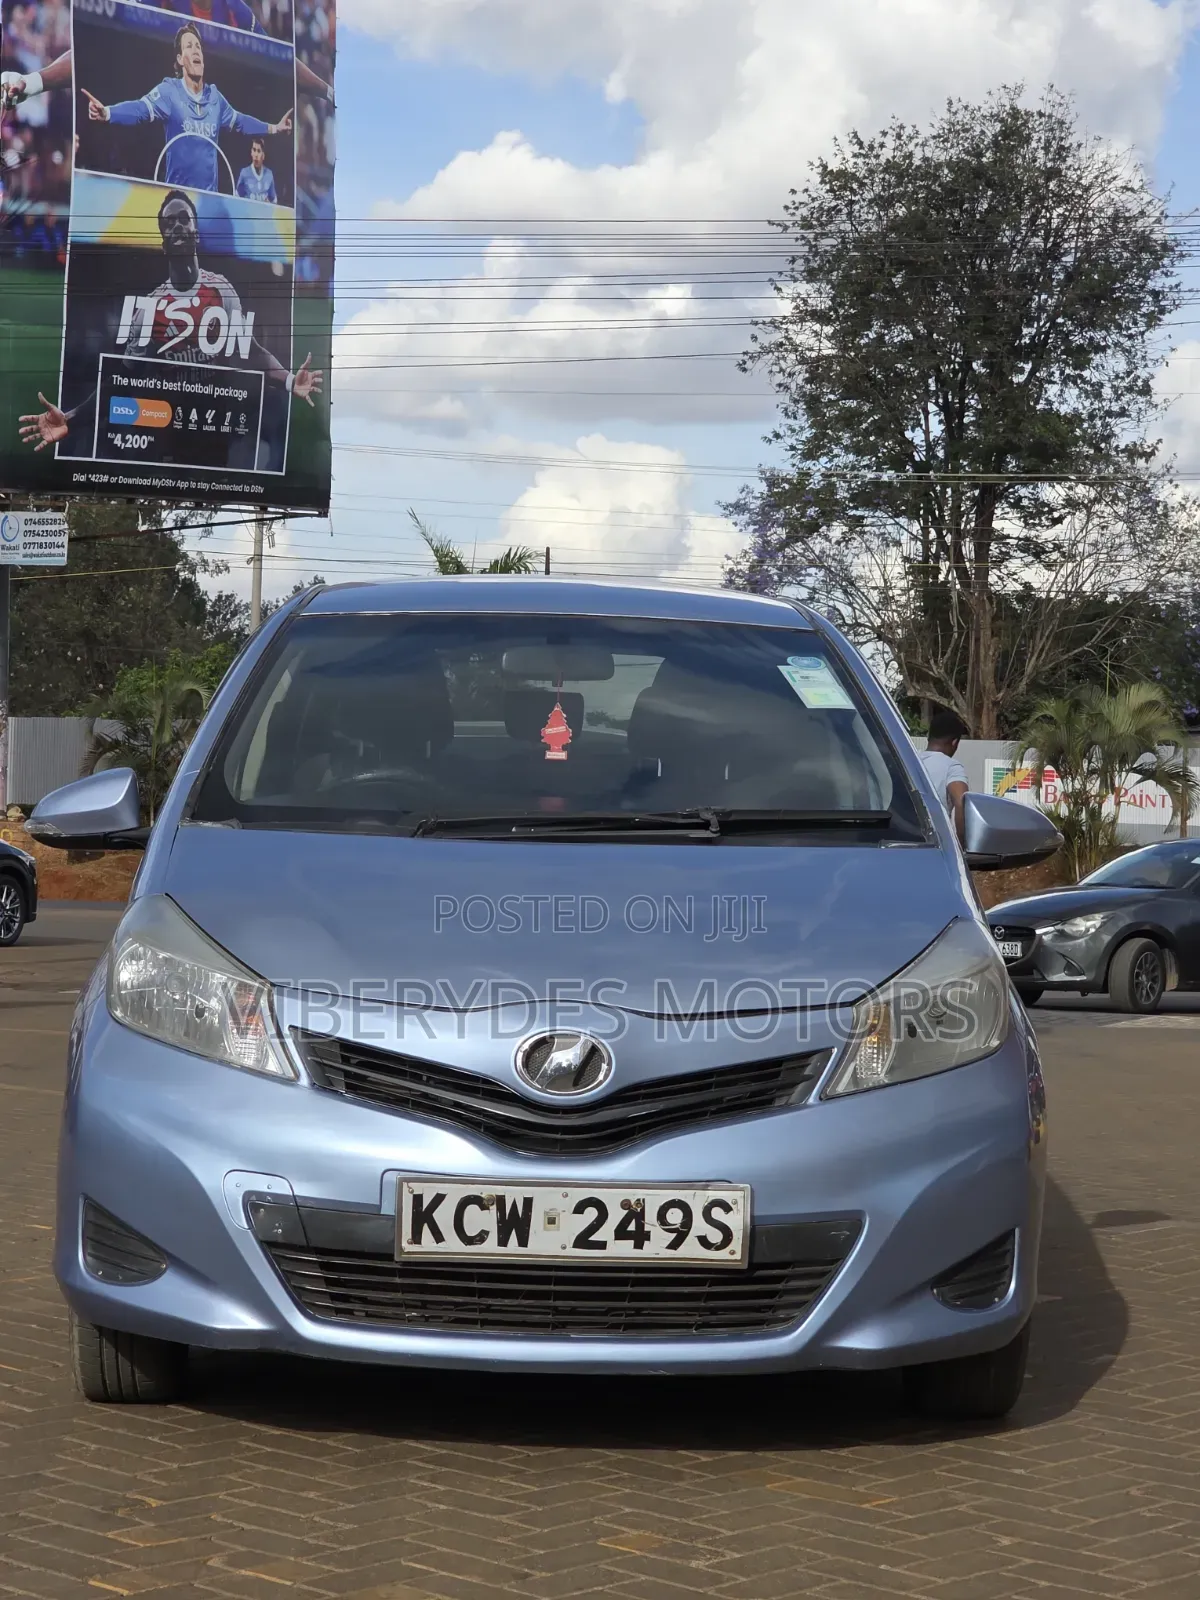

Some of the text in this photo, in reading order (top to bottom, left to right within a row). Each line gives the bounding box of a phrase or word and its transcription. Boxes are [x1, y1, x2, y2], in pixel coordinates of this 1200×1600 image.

[116, 296, 255, 359] IT'S ON
[112, 374, 248, 401] The world's best football package
[112, 406, 168, 419] DStv Compact
[113, 433, 148, 450] 4,200
[72, 473, 87, 482] Dial
[118, 475, 151, 486] Download
[152, 478, 175, 489] MyDStv
[176, 479, 189, 490] App
[197, 482, 210, 491] stay
[211, 482, 243, 492] Connected
[243, 484, 250, 492] to
[250, 485, 265, 494] DStv
[411, 1192, 735, 1252] KCW 249S
